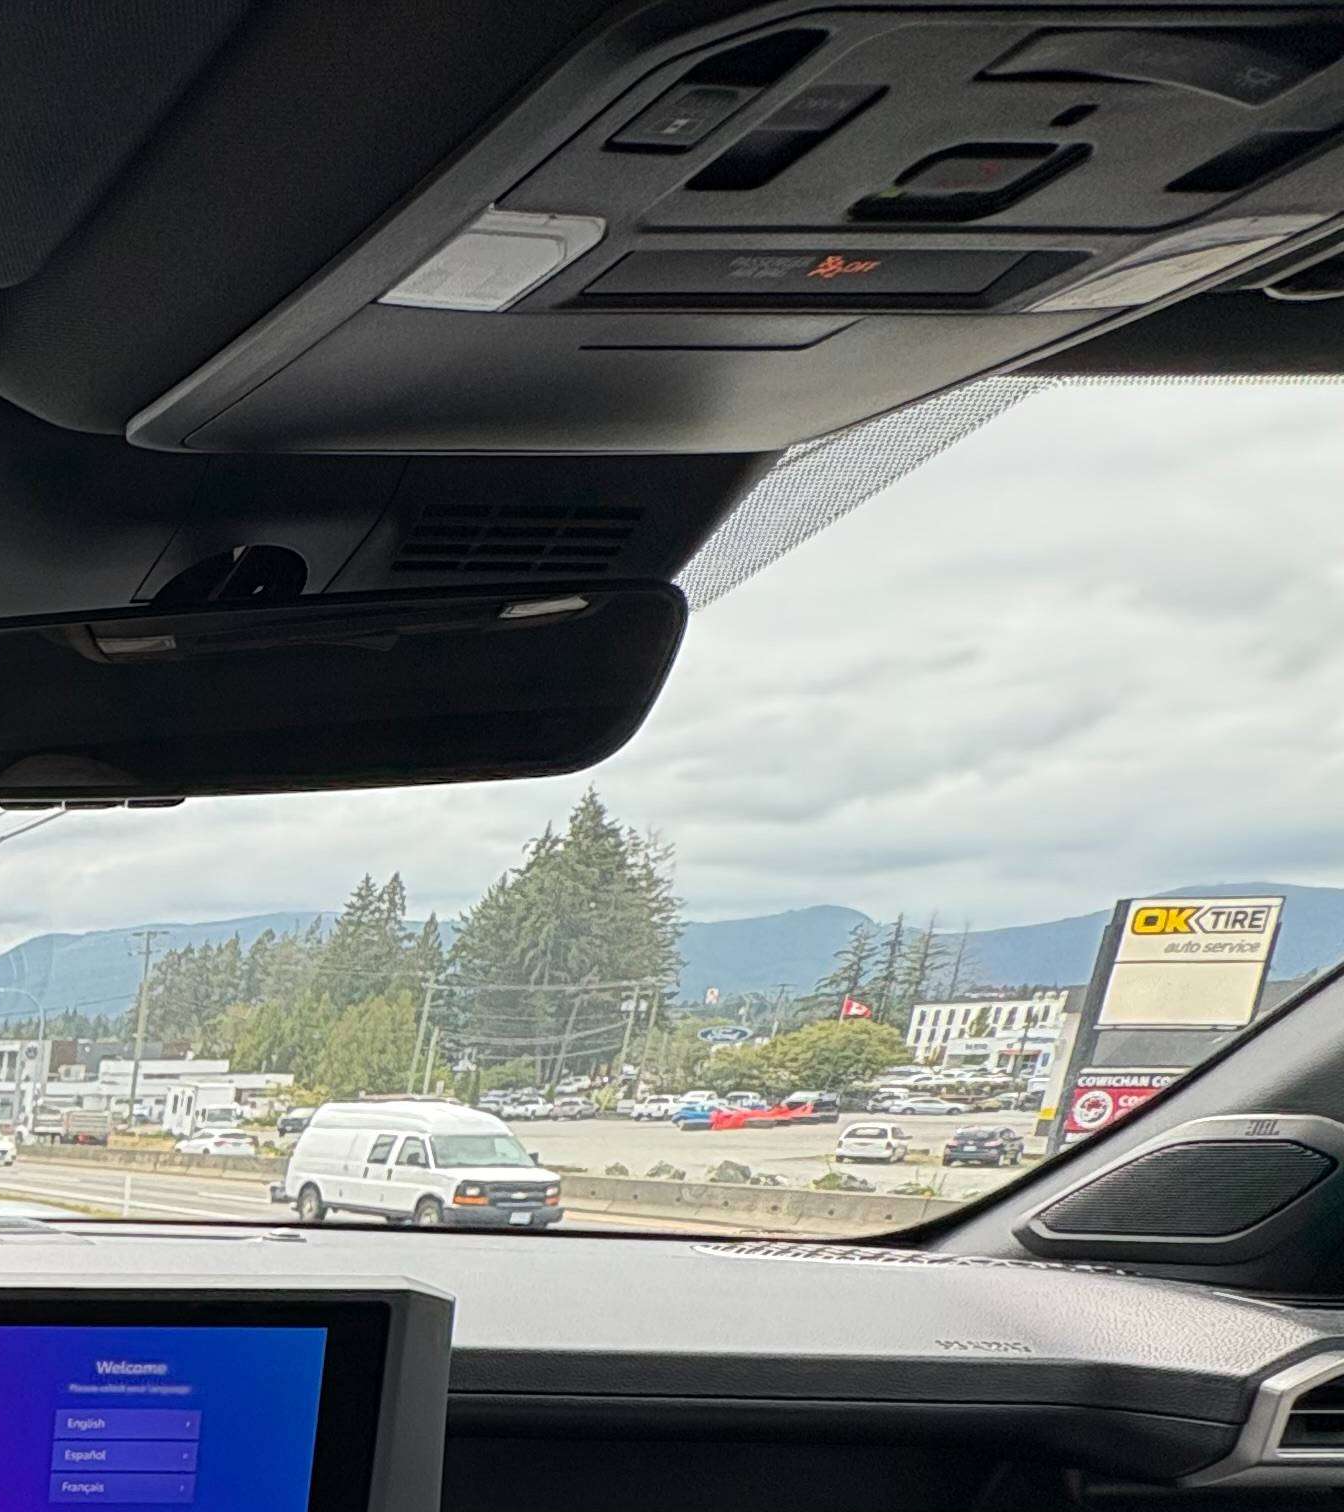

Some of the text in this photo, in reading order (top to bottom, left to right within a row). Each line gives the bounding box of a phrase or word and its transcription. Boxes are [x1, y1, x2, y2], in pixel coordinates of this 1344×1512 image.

[1132, 906, 1266, 935] OK TIRE
[1164, 940, 1261, 954] auto service
[1077, 1076, 1150, 1088] COWICHAN
[96, 1360, 168, 1376] Welcome
[67, 1417, 106, 1431] English
[64, 1449, 107, 1462] Español
[62, 1481, 105, 1495] Français
